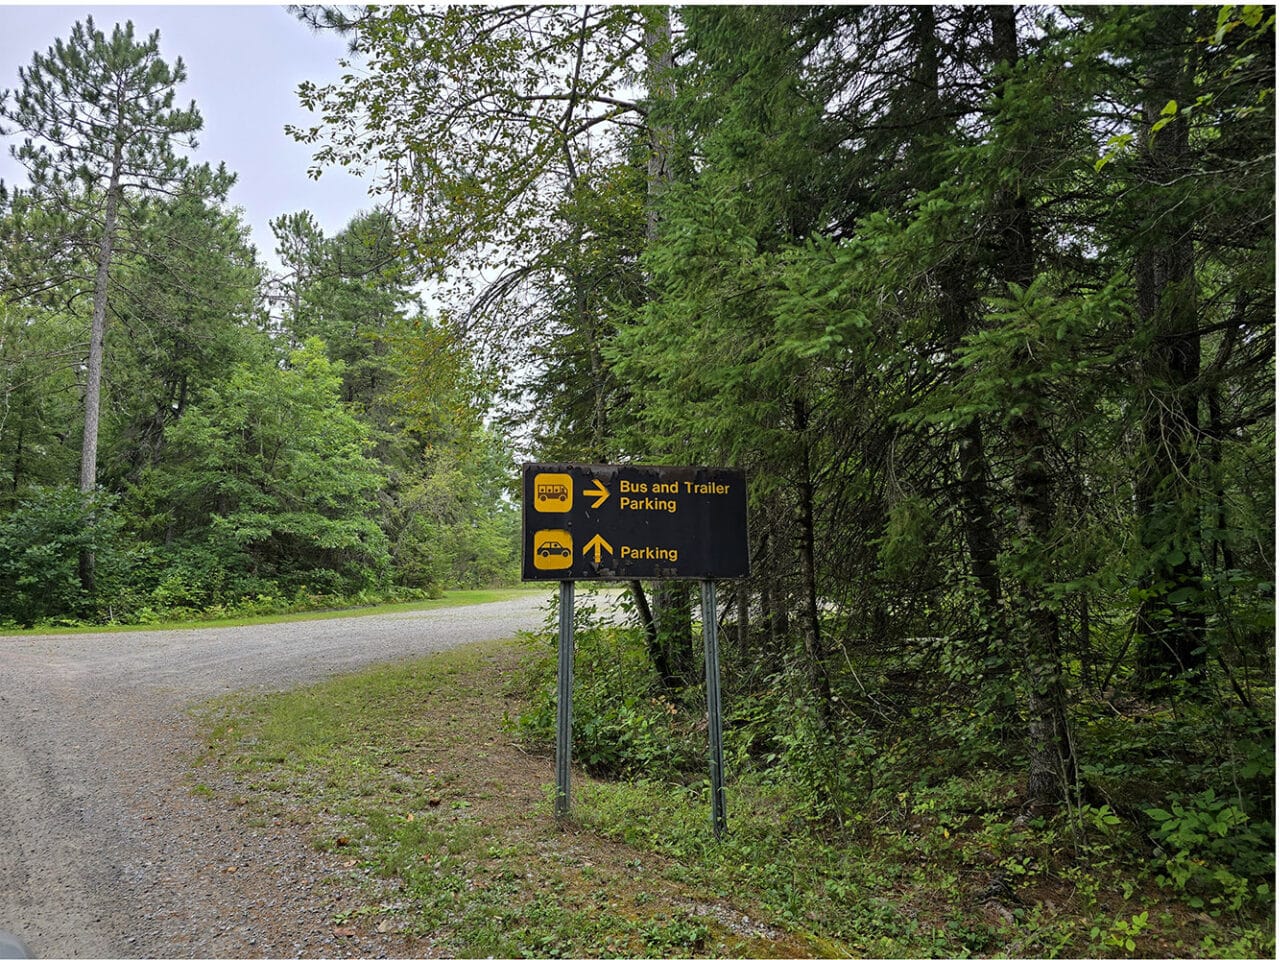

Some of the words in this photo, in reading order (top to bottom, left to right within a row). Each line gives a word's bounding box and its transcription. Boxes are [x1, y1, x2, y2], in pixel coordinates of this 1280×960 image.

[620, 480, 648, 493] Bus
[652, 481, 679, 494] and
[684, 481, 730, 494] Trailer
[620, 497, 677, 513] Parking
[620, 546, 678, 562] Parking
